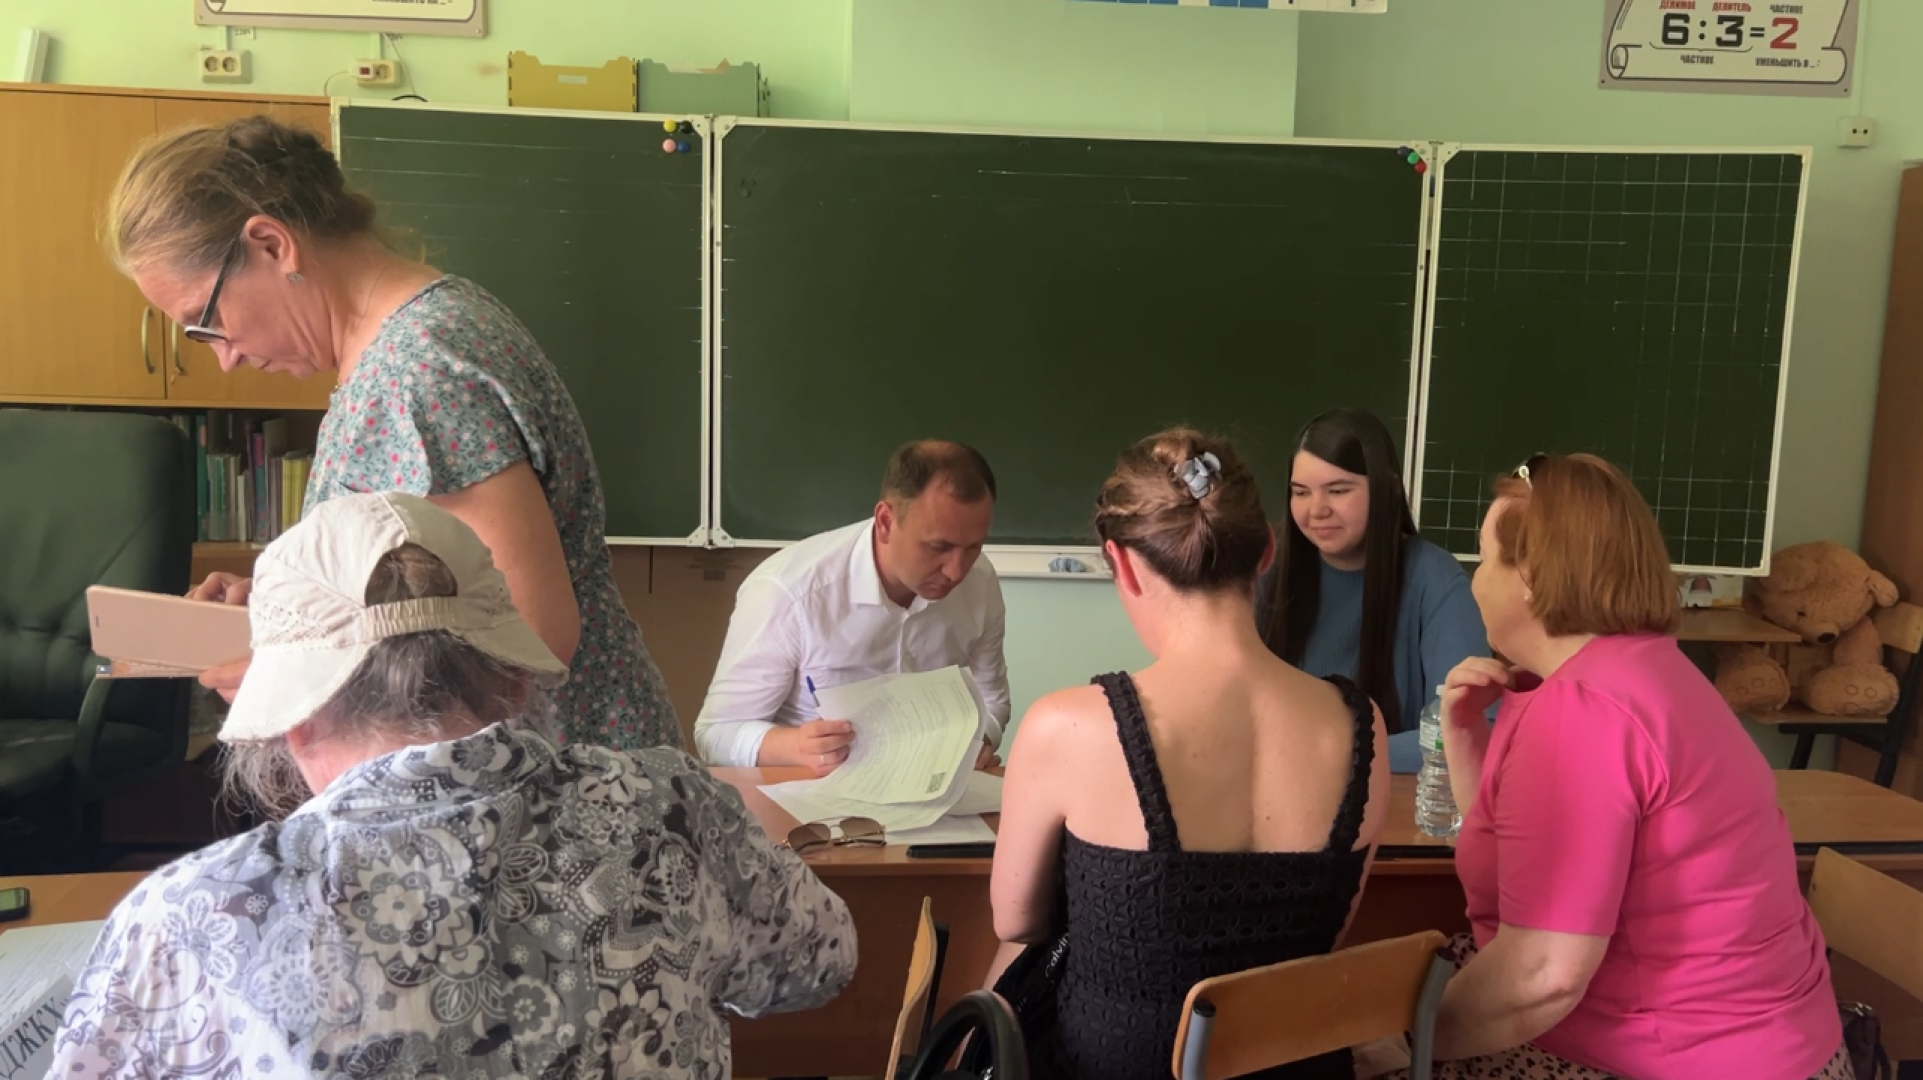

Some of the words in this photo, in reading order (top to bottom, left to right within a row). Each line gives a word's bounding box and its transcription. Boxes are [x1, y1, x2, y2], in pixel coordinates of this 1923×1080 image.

[1712, 2, 1752, 12] ДЕЛИТЕЛЬ
[1771, 4, 1804, 14] ЧАСТНОЕ
[1680, 54, 1714, 65] ЧАСТНОЕ
